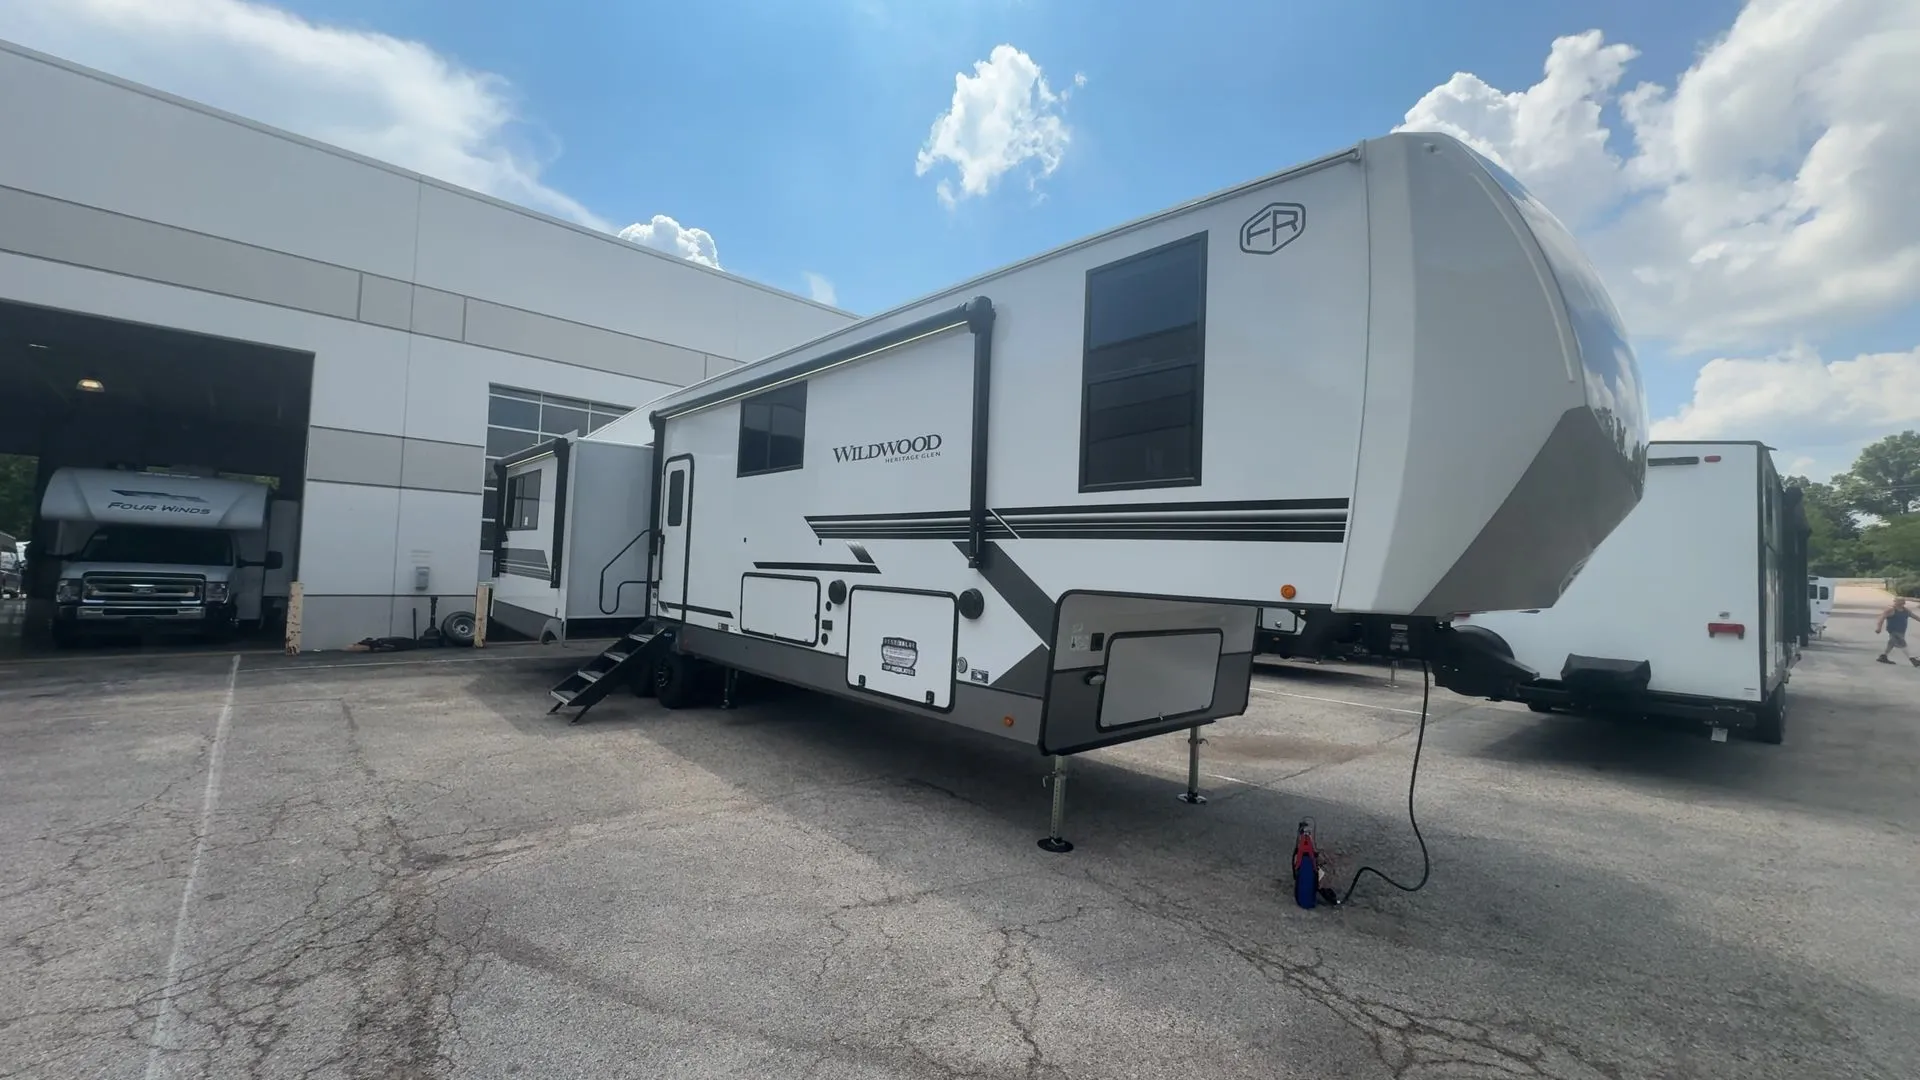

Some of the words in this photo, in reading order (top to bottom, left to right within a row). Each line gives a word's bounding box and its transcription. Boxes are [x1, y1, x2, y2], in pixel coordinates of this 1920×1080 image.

[833, 434, 942, 463] WILDWOOD
[885, 454, 920, 463] HERITAGE
[921, 451, 941, 459] GLEN
[107, 502, 157, 511] FOUR
